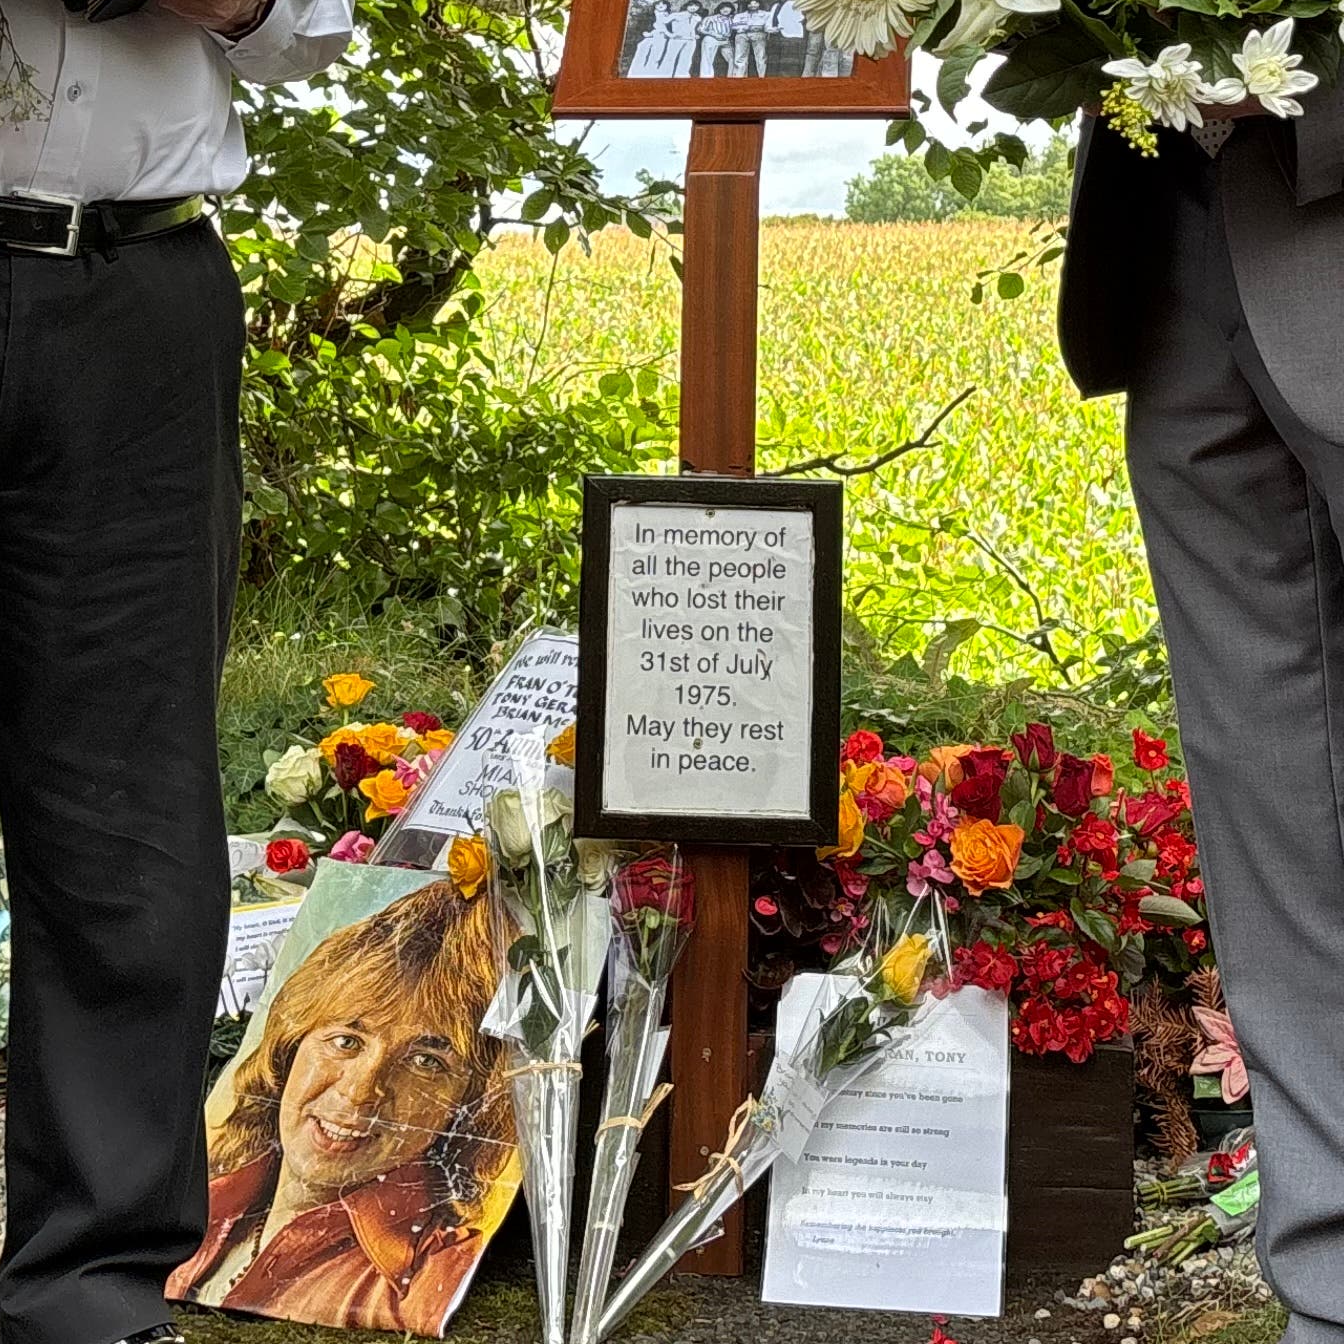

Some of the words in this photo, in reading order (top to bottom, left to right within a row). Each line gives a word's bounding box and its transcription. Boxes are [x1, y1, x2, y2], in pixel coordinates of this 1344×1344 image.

[635, 523, 655, 544] In
[664, 528, 757, 551] memory
[764, 527, 787, 547] of
[632, 556, 656, 575] all
[666, 556, 700, 577] the
[709, 559, 787, 583] people
[632, 588, 679, 608] who
[687, 588, 726, 609] lost
[734, 590, 786, 611] their
[642, 619, 693, 641] lives
[701, 623, 729, 642] on
[737, 621, 774, 643] the
[640, 651, 689, 673] 31st
[697, 652, 720, 673] of
[726, 651, 773, 680] July
[506, 674, 547, 691] FRAN
[492, 692, 533, 706] TONY
[674, 685, 737, 706] 1975.
[491, 706, 542, 723] BRIAN
[627, 714, 675, 741] May
[683, 717, 733, 743] they
[740, 721, 784, 740] rest
[651, 748, 670, 769] in
[679, 753, 756, 774] peace.
[459, 781, 498, 798] SHO
[885, 1048, 919, 1062] RAN,
[925, 1050, 967, 1064] TONY
